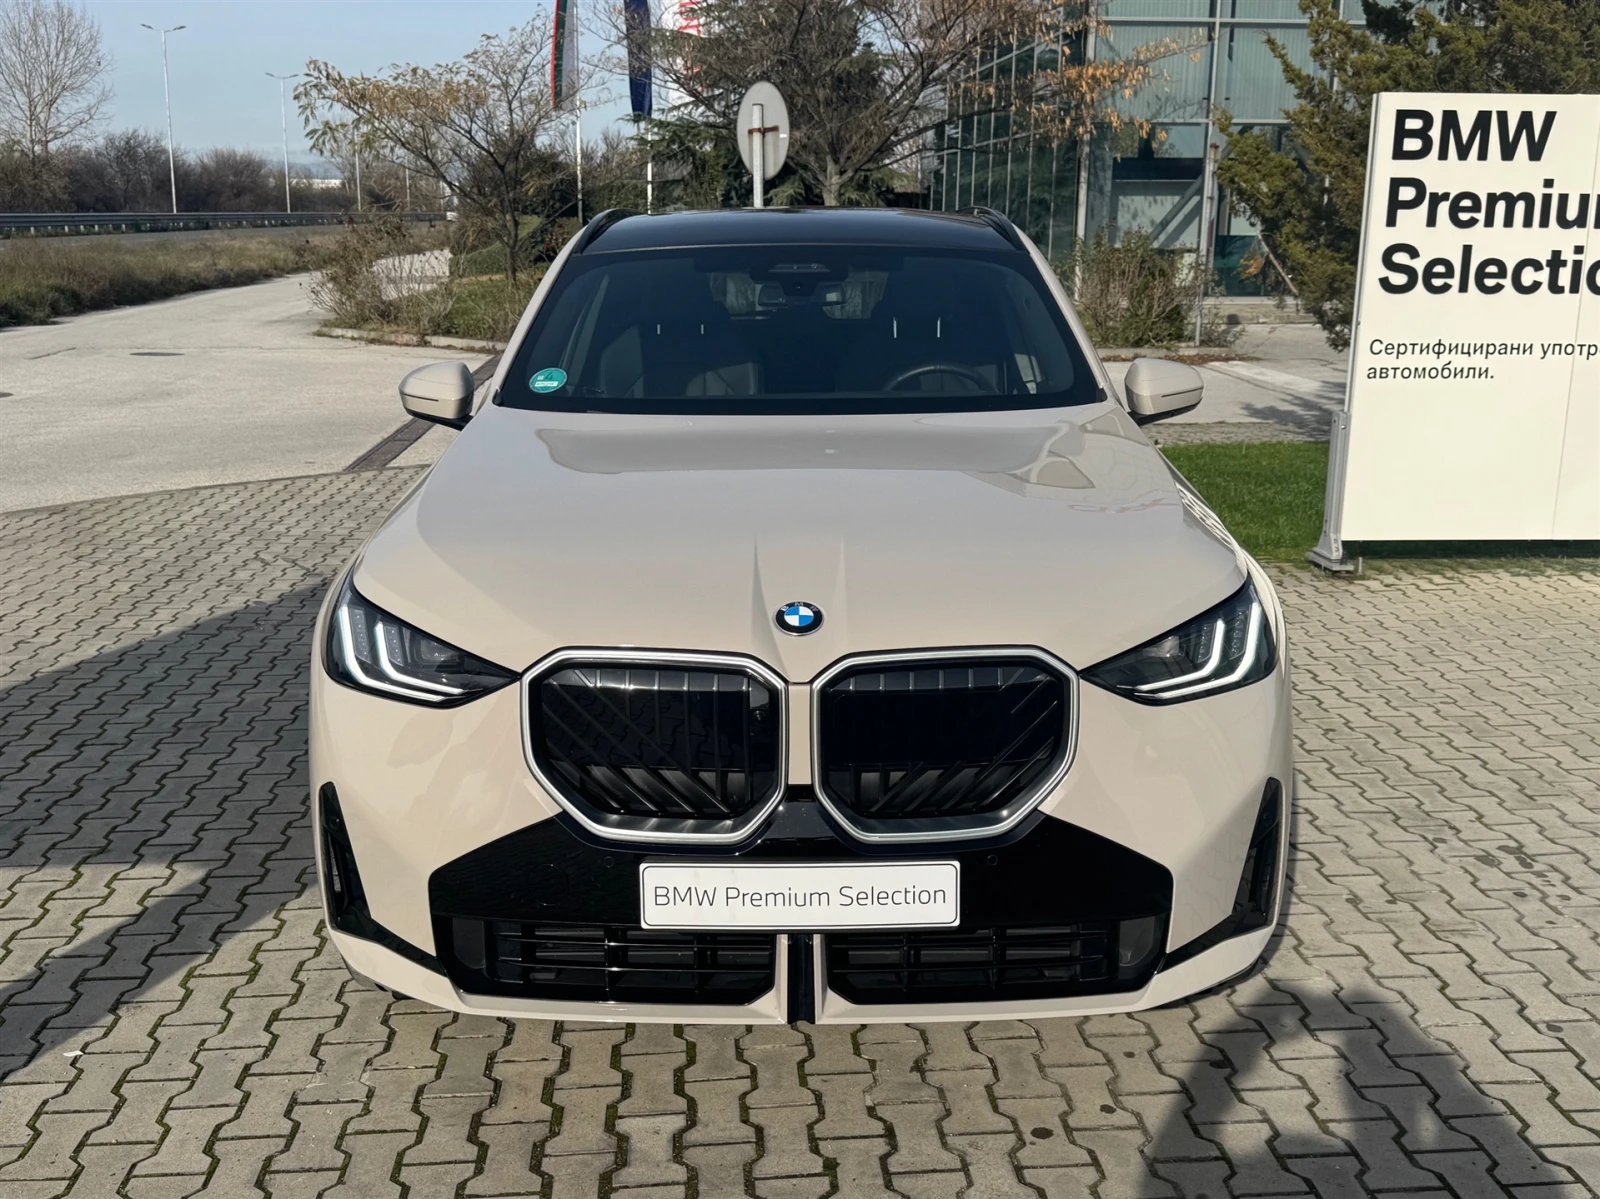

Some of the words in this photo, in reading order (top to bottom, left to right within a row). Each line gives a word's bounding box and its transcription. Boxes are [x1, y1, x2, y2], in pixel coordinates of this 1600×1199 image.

[1391, 109, 1557, 162] BMW
[1385, 176, 1600, 230] Premiu
[1369, 338, 1534, 360] Сертифицирани
[1540, 342, 1600, 361] употр
[1366, 360, 1495, 380] автомобили.
[653, 886, 717, 907] BMW
[725, 886, 831, 908] Premium
[838, 884, 947, 907] Selection
